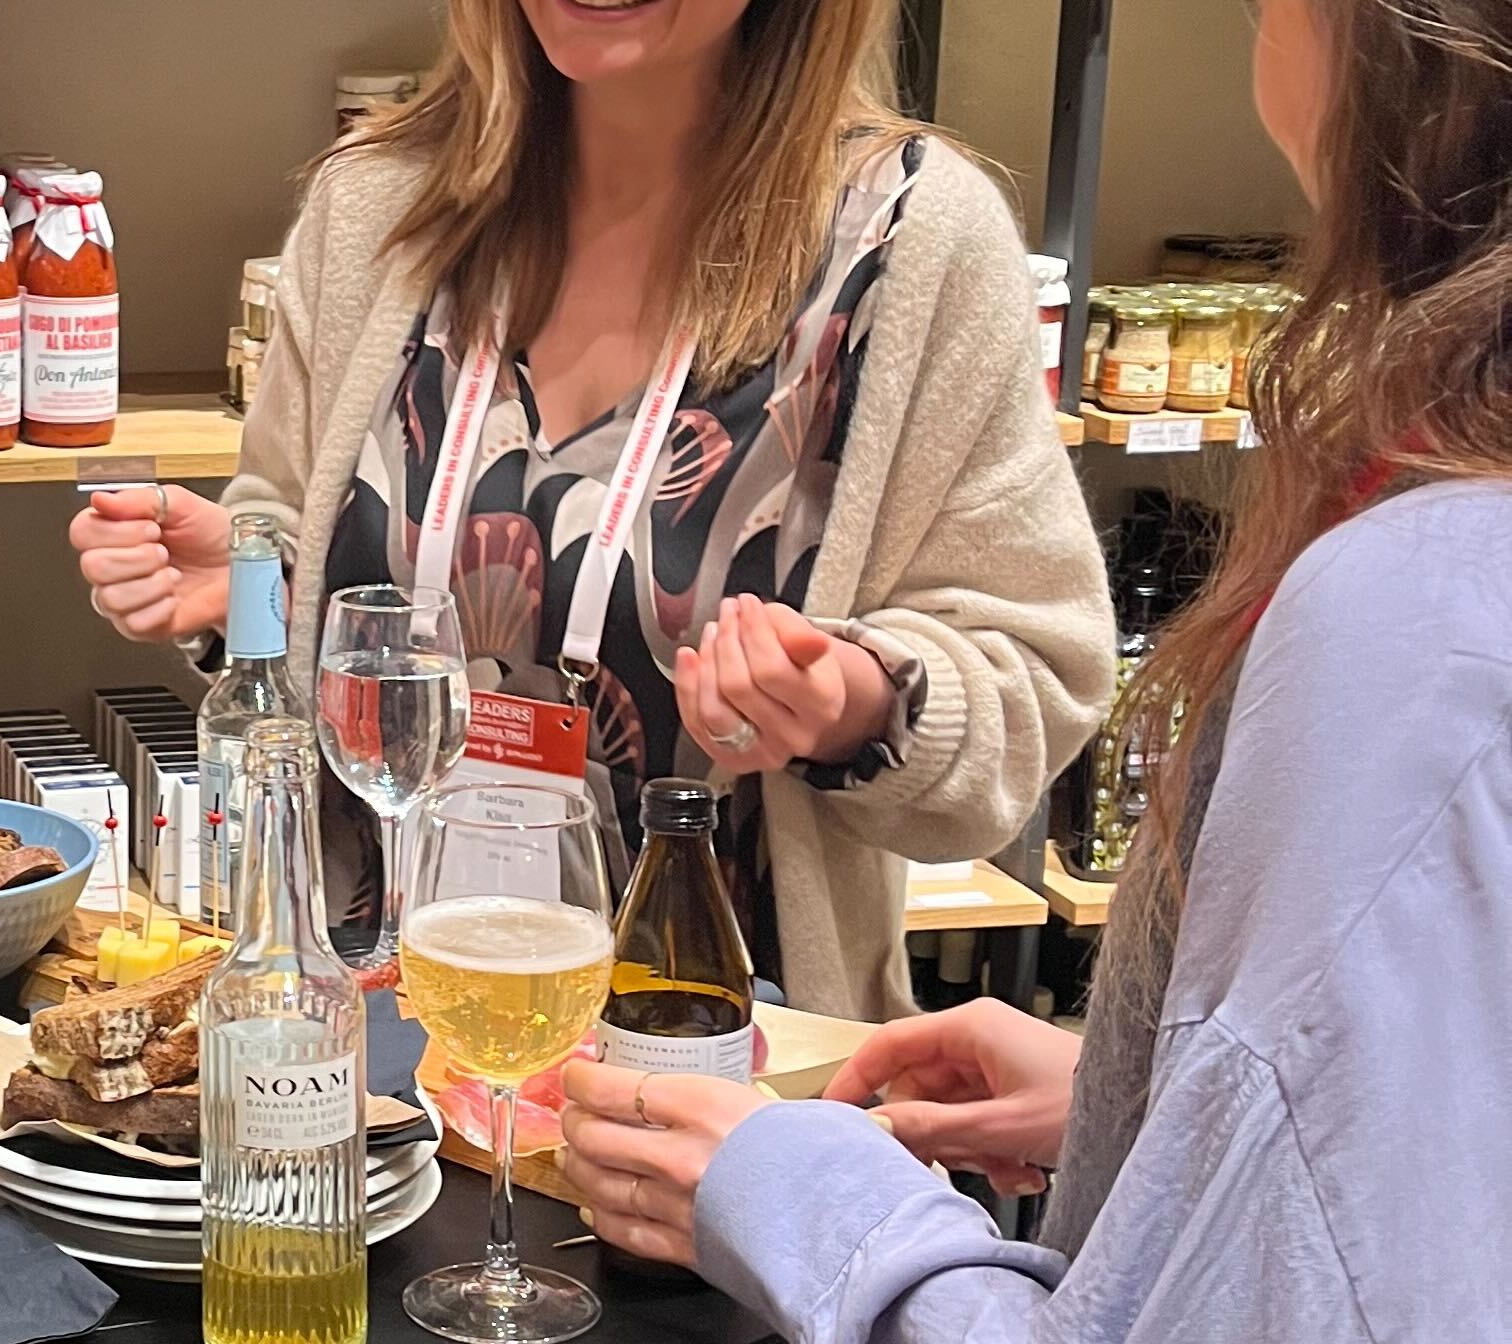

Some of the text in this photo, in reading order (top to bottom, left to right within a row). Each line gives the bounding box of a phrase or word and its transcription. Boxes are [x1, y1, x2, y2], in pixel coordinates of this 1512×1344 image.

[58, 317, 71, 332] DI
[46, 333, 60, 350] AL
[35, 365, 66, 385] Don
[432, 381, 481, 531] LEADERS IN CONSULTING
[599, 394, 665, 548] LEADERS IN CONSULTING
[472, 700, 531, 722] EADERS
[469, 723, 529, 743] ONSULTING
[245, 1068, 347, 1097] NOAM
[247, 1092, 349, 1109] BAVARIA BERLIN
